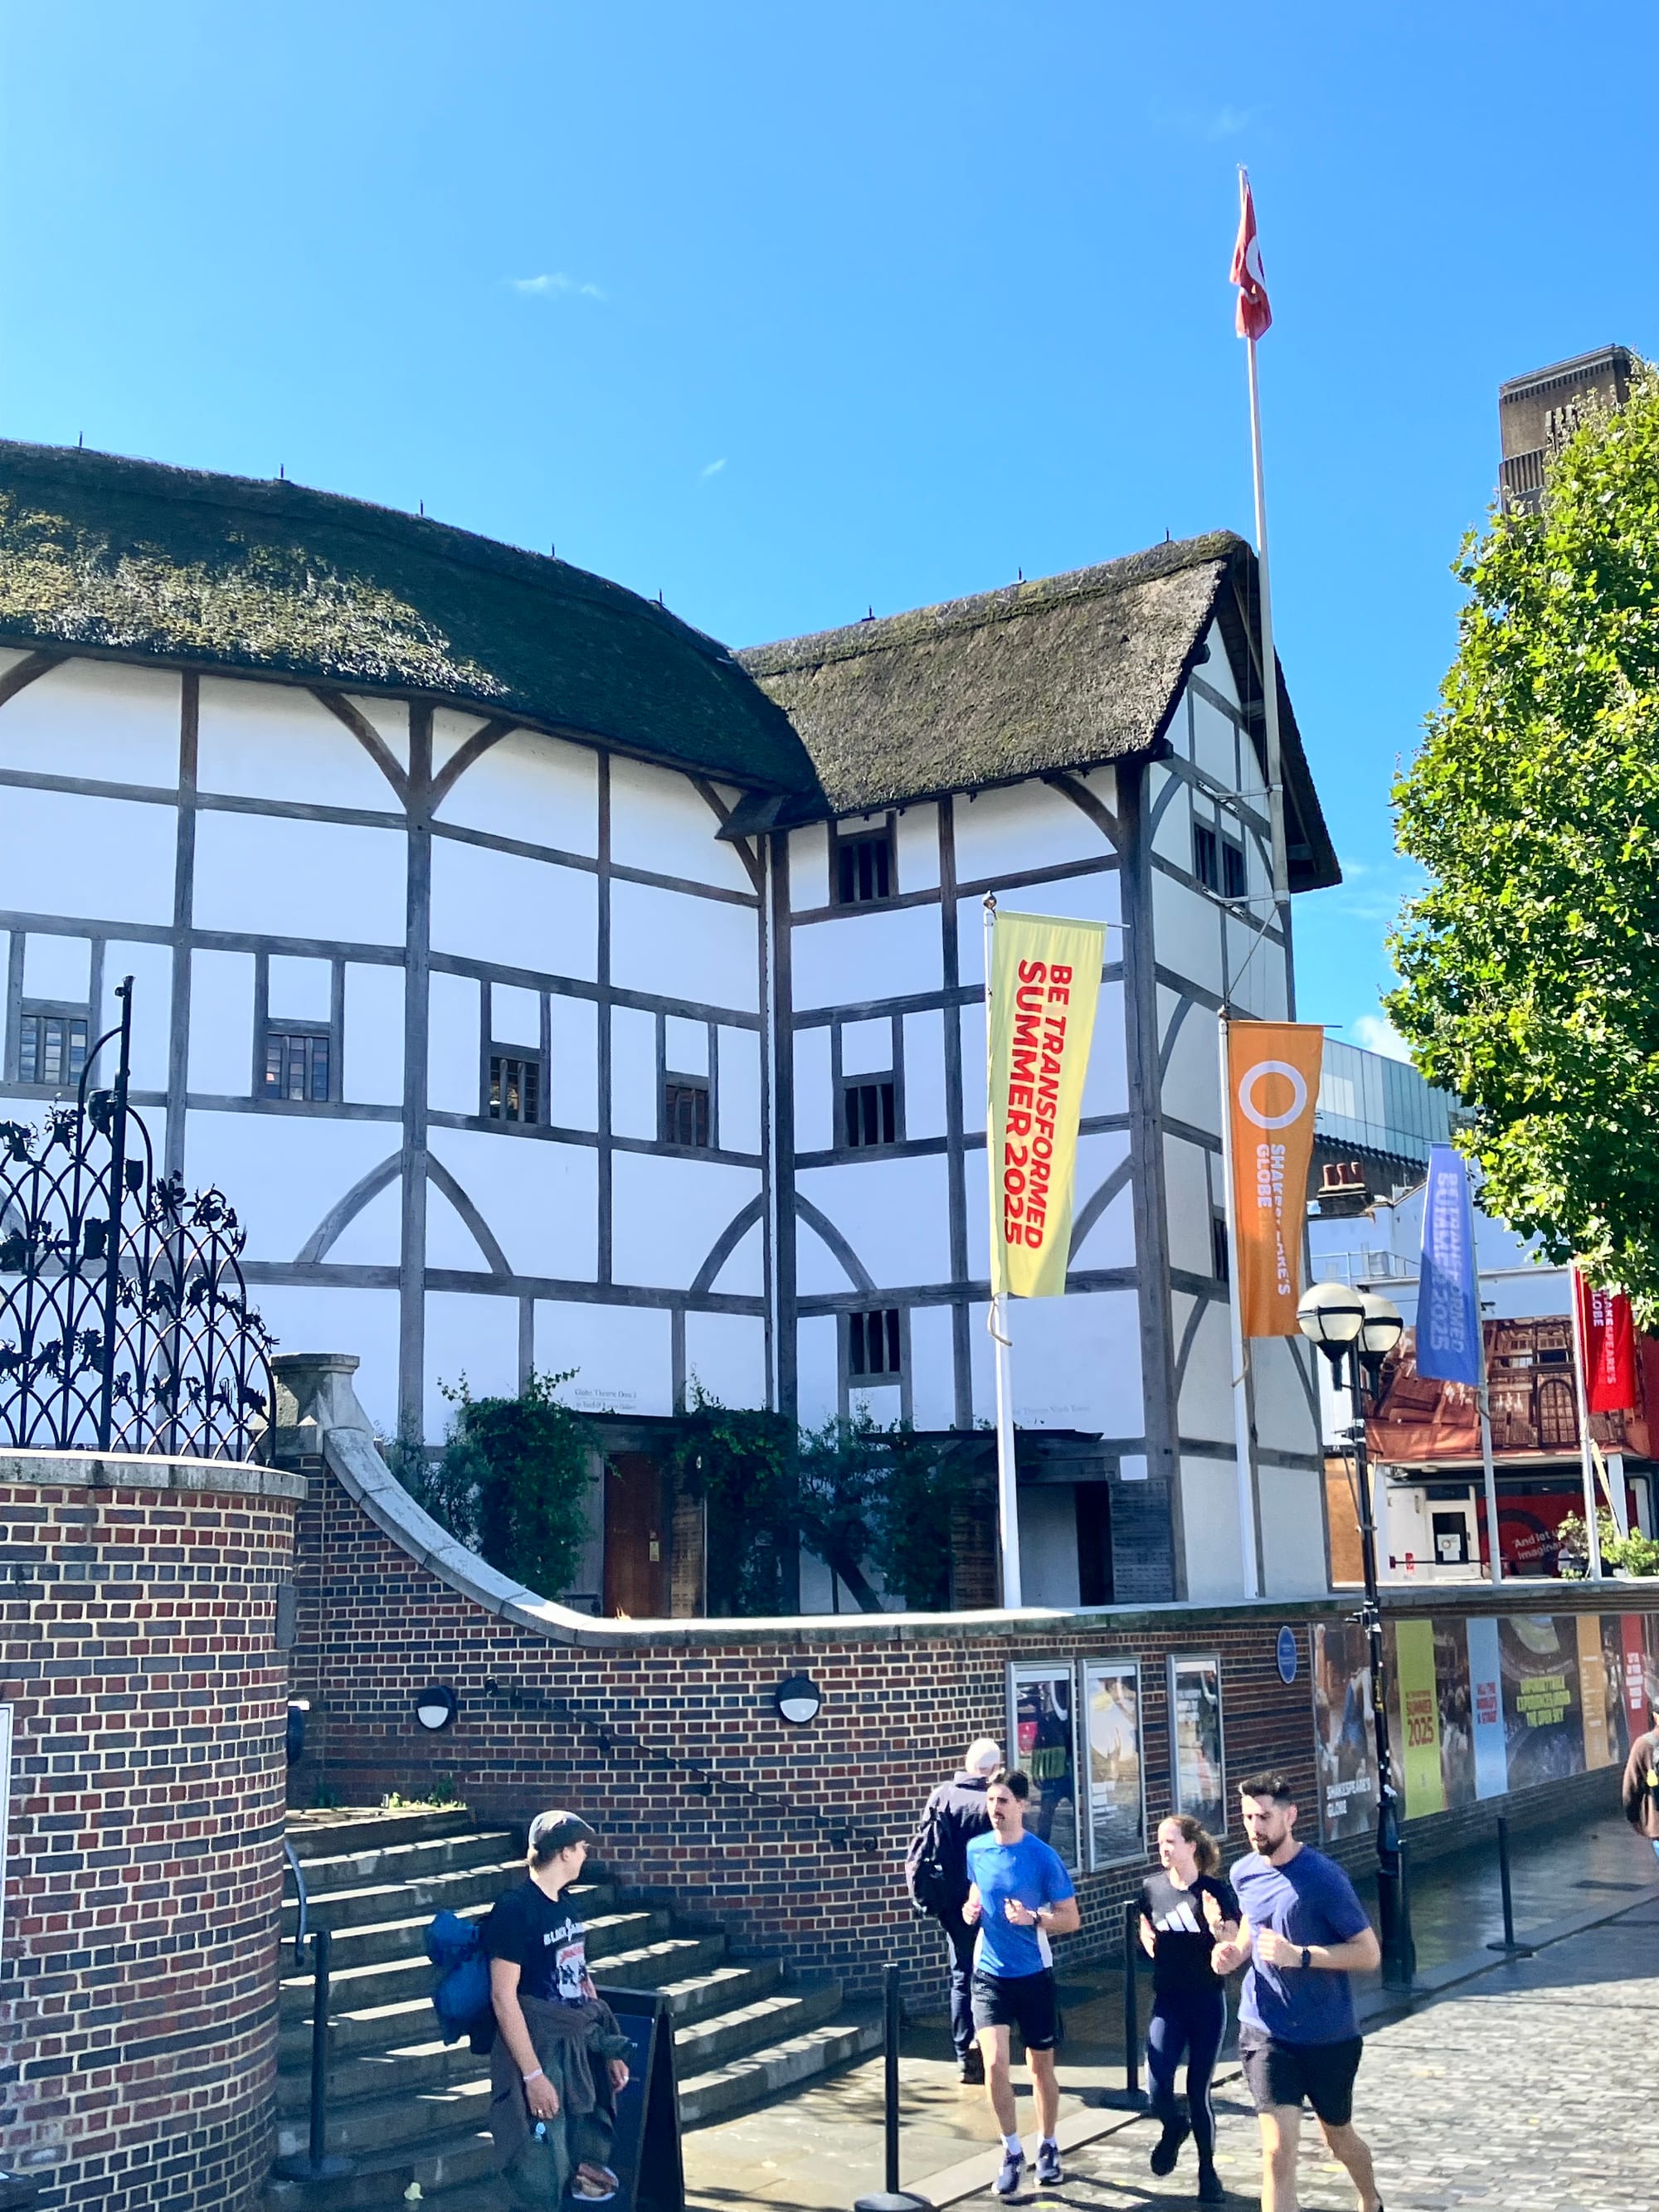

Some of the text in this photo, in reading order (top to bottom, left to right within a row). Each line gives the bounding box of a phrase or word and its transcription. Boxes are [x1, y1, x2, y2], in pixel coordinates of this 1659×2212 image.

[1005, 960, 1048, 1246] SUMMER 2025
[1024, 964, 1073, 1249] BE TRANSFORMED
[1257, 1144, 1272, 1208] GLOBE
[1430, 1288, 1449, 1350] 2025
[1593, 1291, 1604, 1327] LOBE
[1535, 1530, 1551, 1543] let
[1407, 1716, 1434, 1747] 2025
